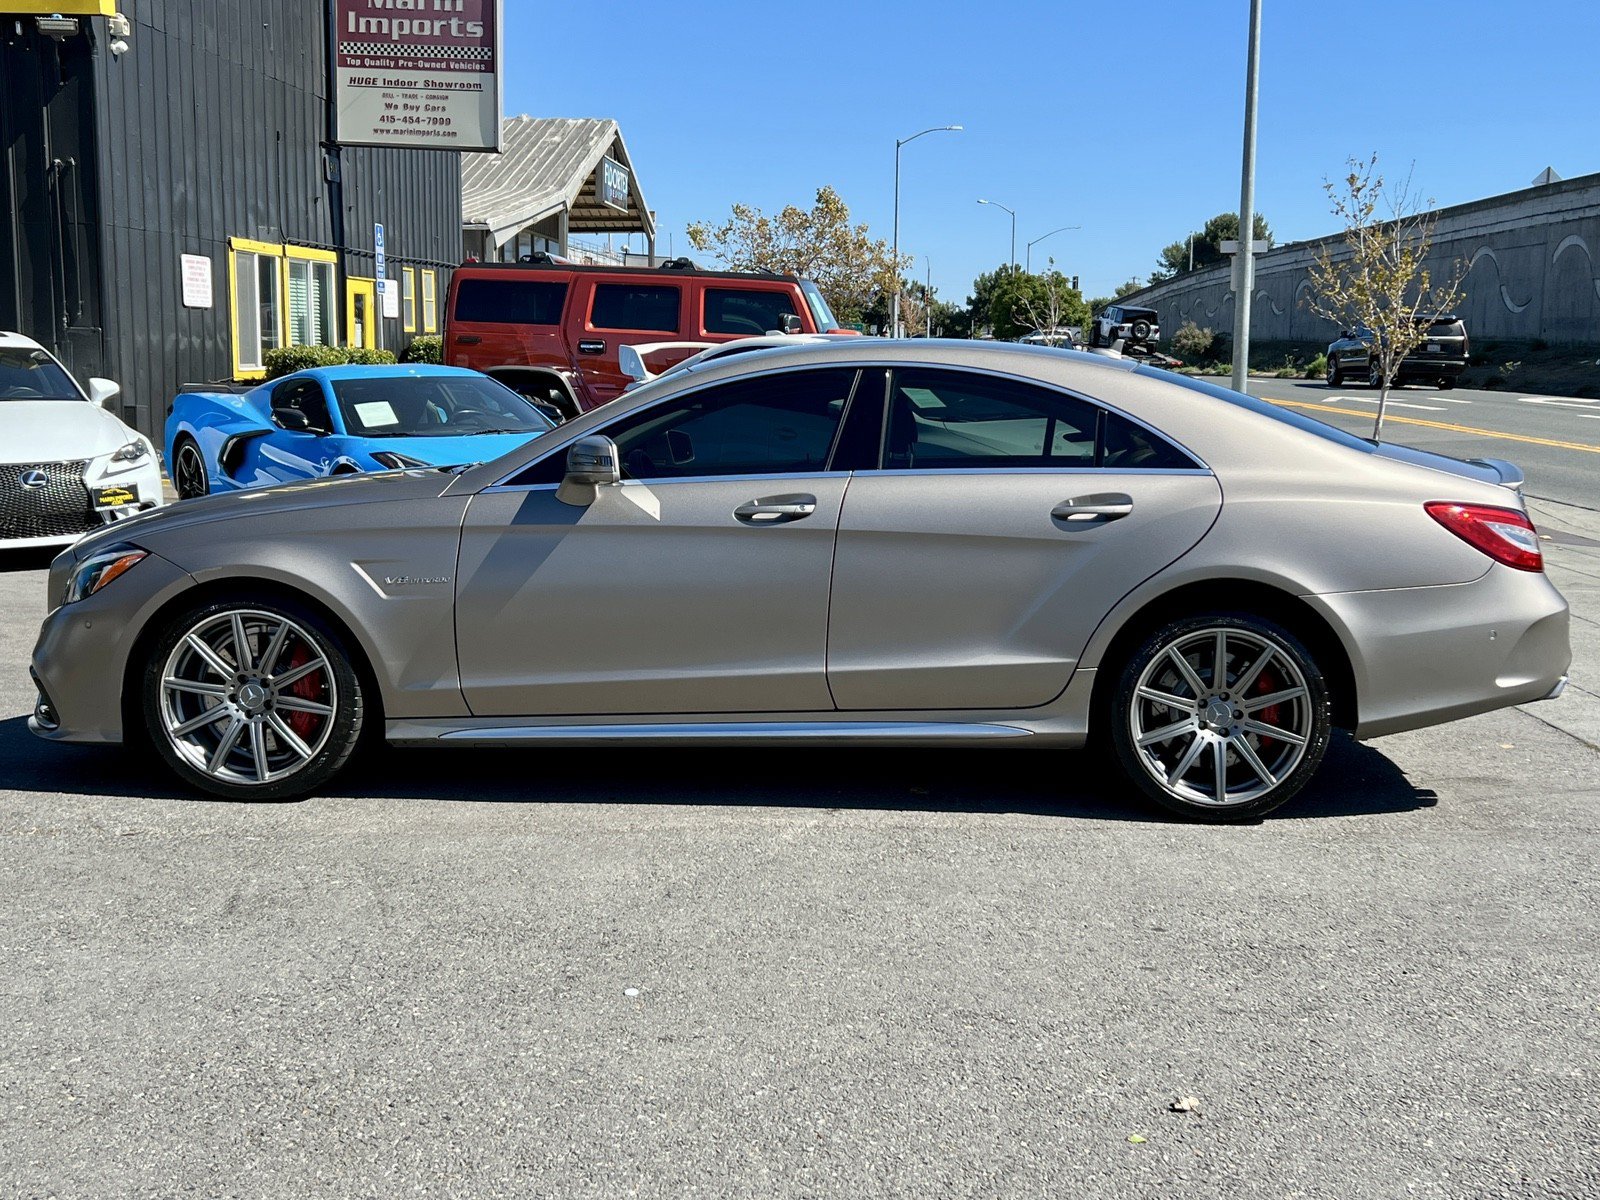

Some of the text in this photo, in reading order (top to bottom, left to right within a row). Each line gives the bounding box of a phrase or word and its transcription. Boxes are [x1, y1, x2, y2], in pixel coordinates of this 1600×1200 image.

[347, 11, 484, 40] Imports
[345, 57, 486, 71] Top Quality Pre-Owned Vehicles
[349, 76, 482, 90] HUGE Indoor Showroom
[384, 102, 447, 112] We Buy Cars
[379, 114, 451, 126] 415-454-7999
[373, 128, 458, 138] www.marinimports.com
